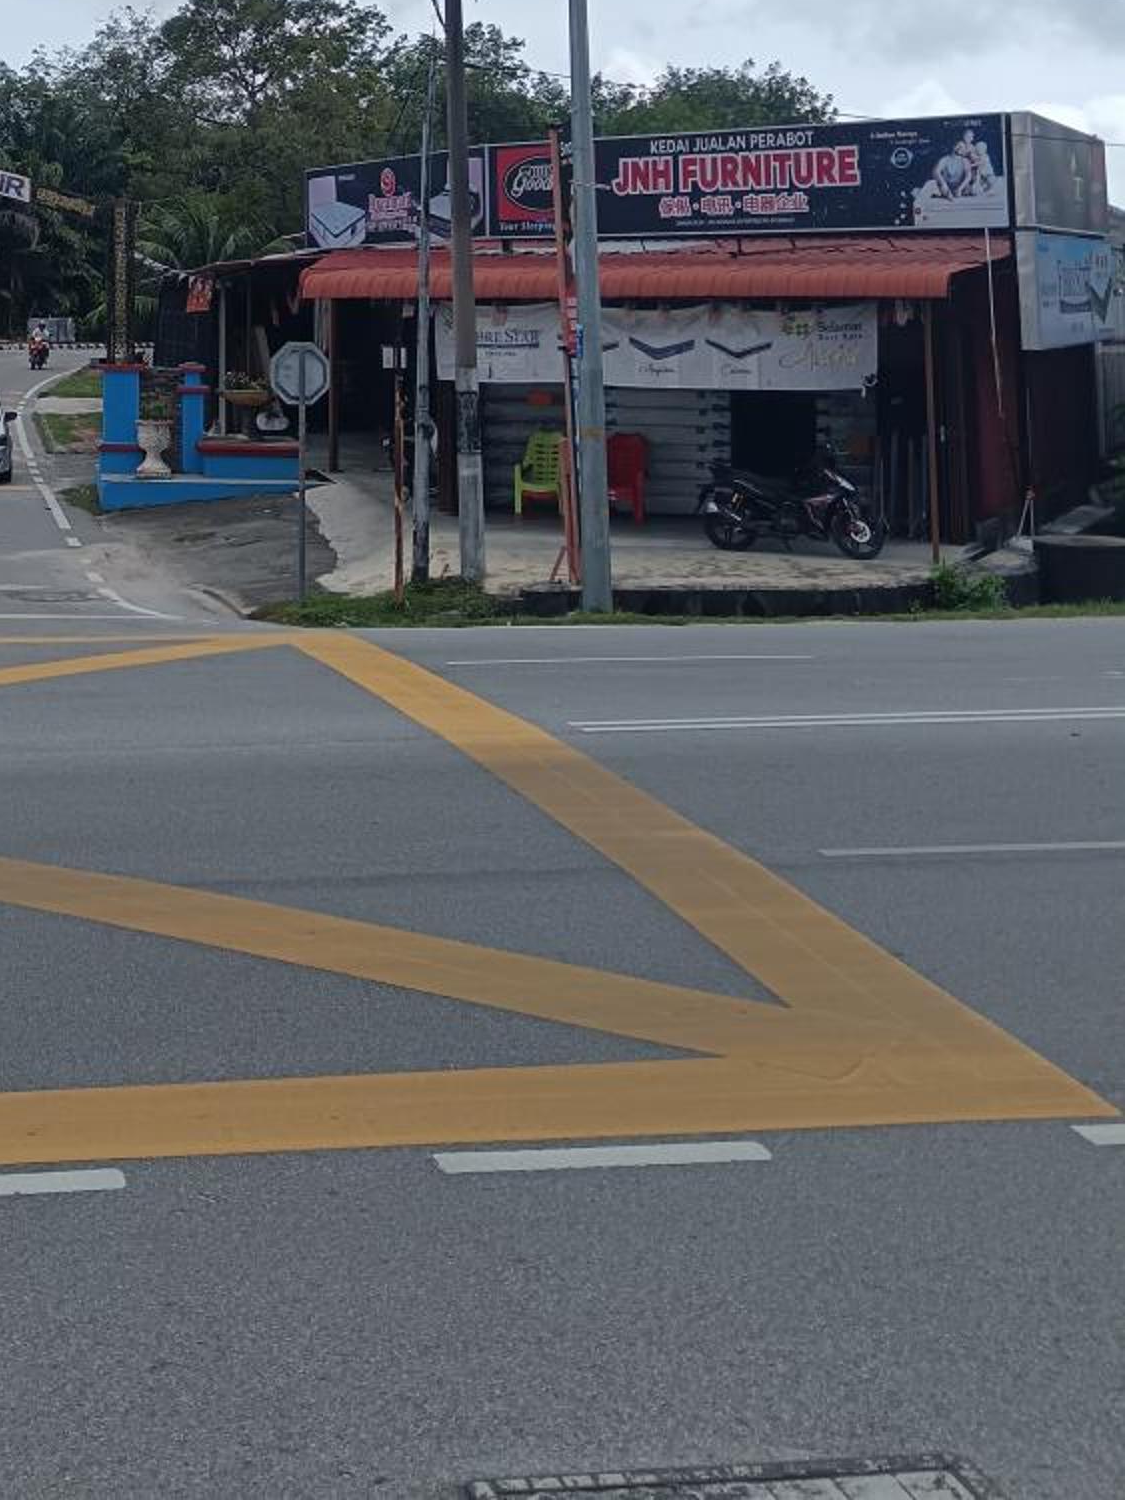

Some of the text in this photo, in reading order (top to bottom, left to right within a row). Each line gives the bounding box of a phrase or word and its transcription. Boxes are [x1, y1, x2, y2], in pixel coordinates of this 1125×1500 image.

[650, 131, 814, 155] KEDAI JUALAN PERABOT
[613, 145, 860, 195] JNH FURNITURE
